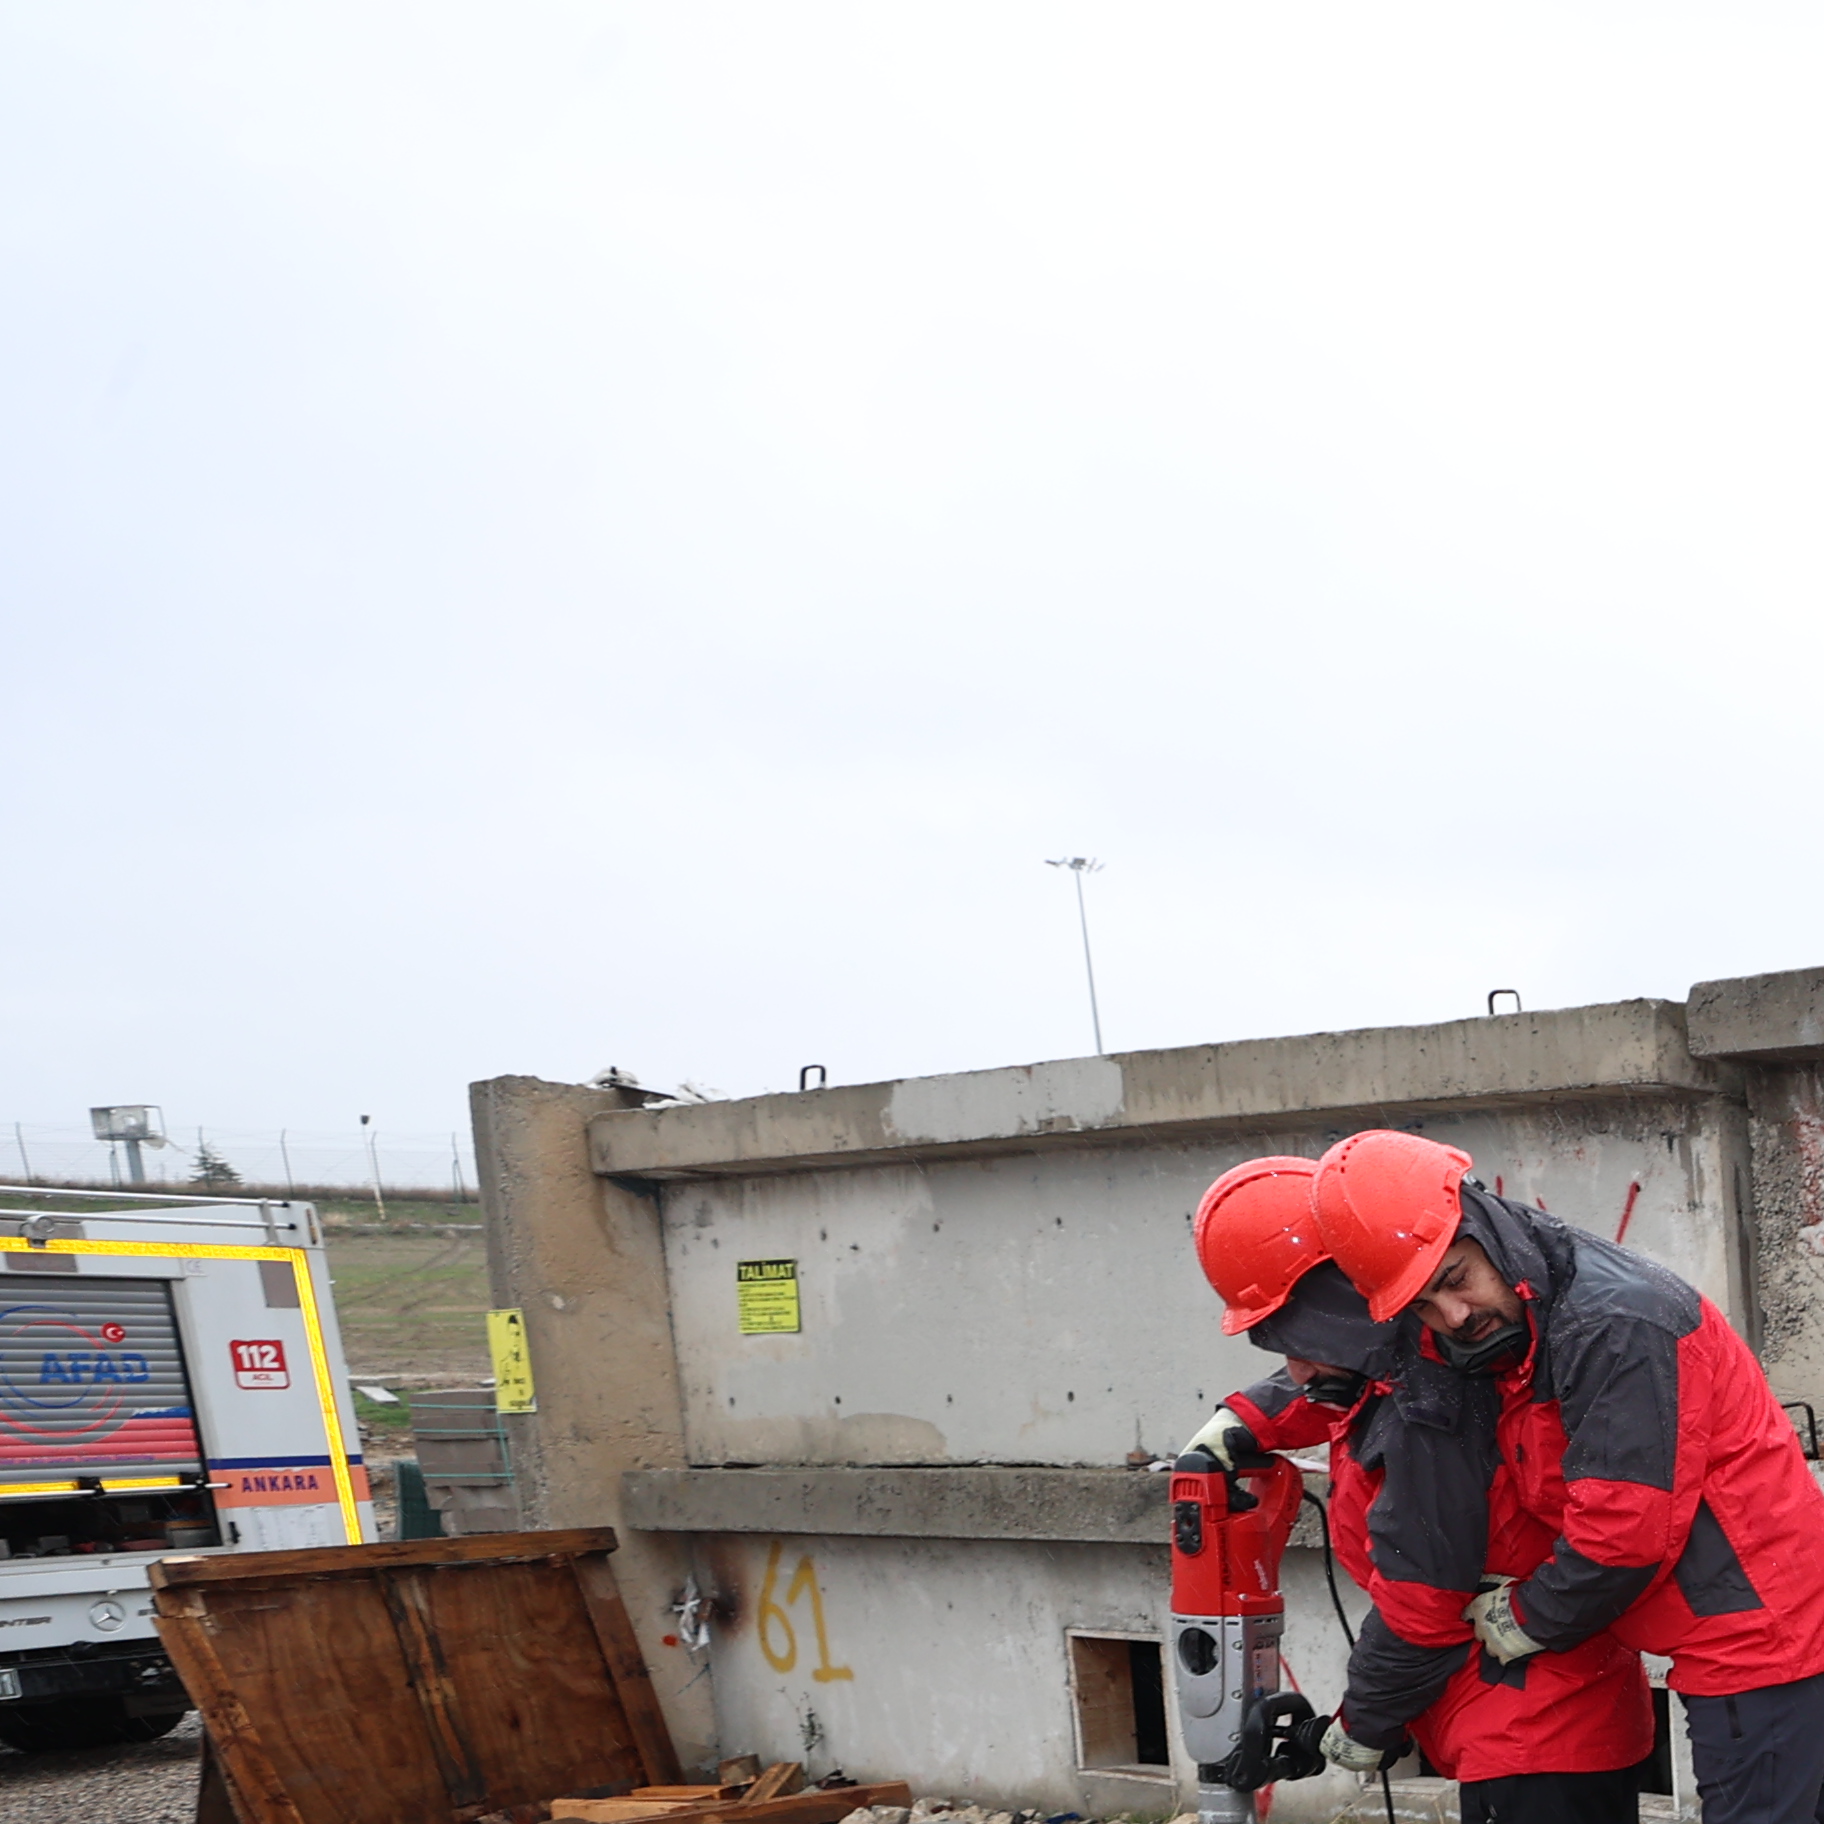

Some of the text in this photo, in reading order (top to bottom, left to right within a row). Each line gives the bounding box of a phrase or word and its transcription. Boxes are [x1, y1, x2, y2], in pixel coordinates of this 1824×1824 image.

[740, 1262, 793, 1280] TALİMAT
[40, 1352, 149, 1384] AFAD
[237, 1344, 280, 1368] 112
[241, 1474, 320, 1493] ANKARA
[757, 1540, 855, 1683] 61
